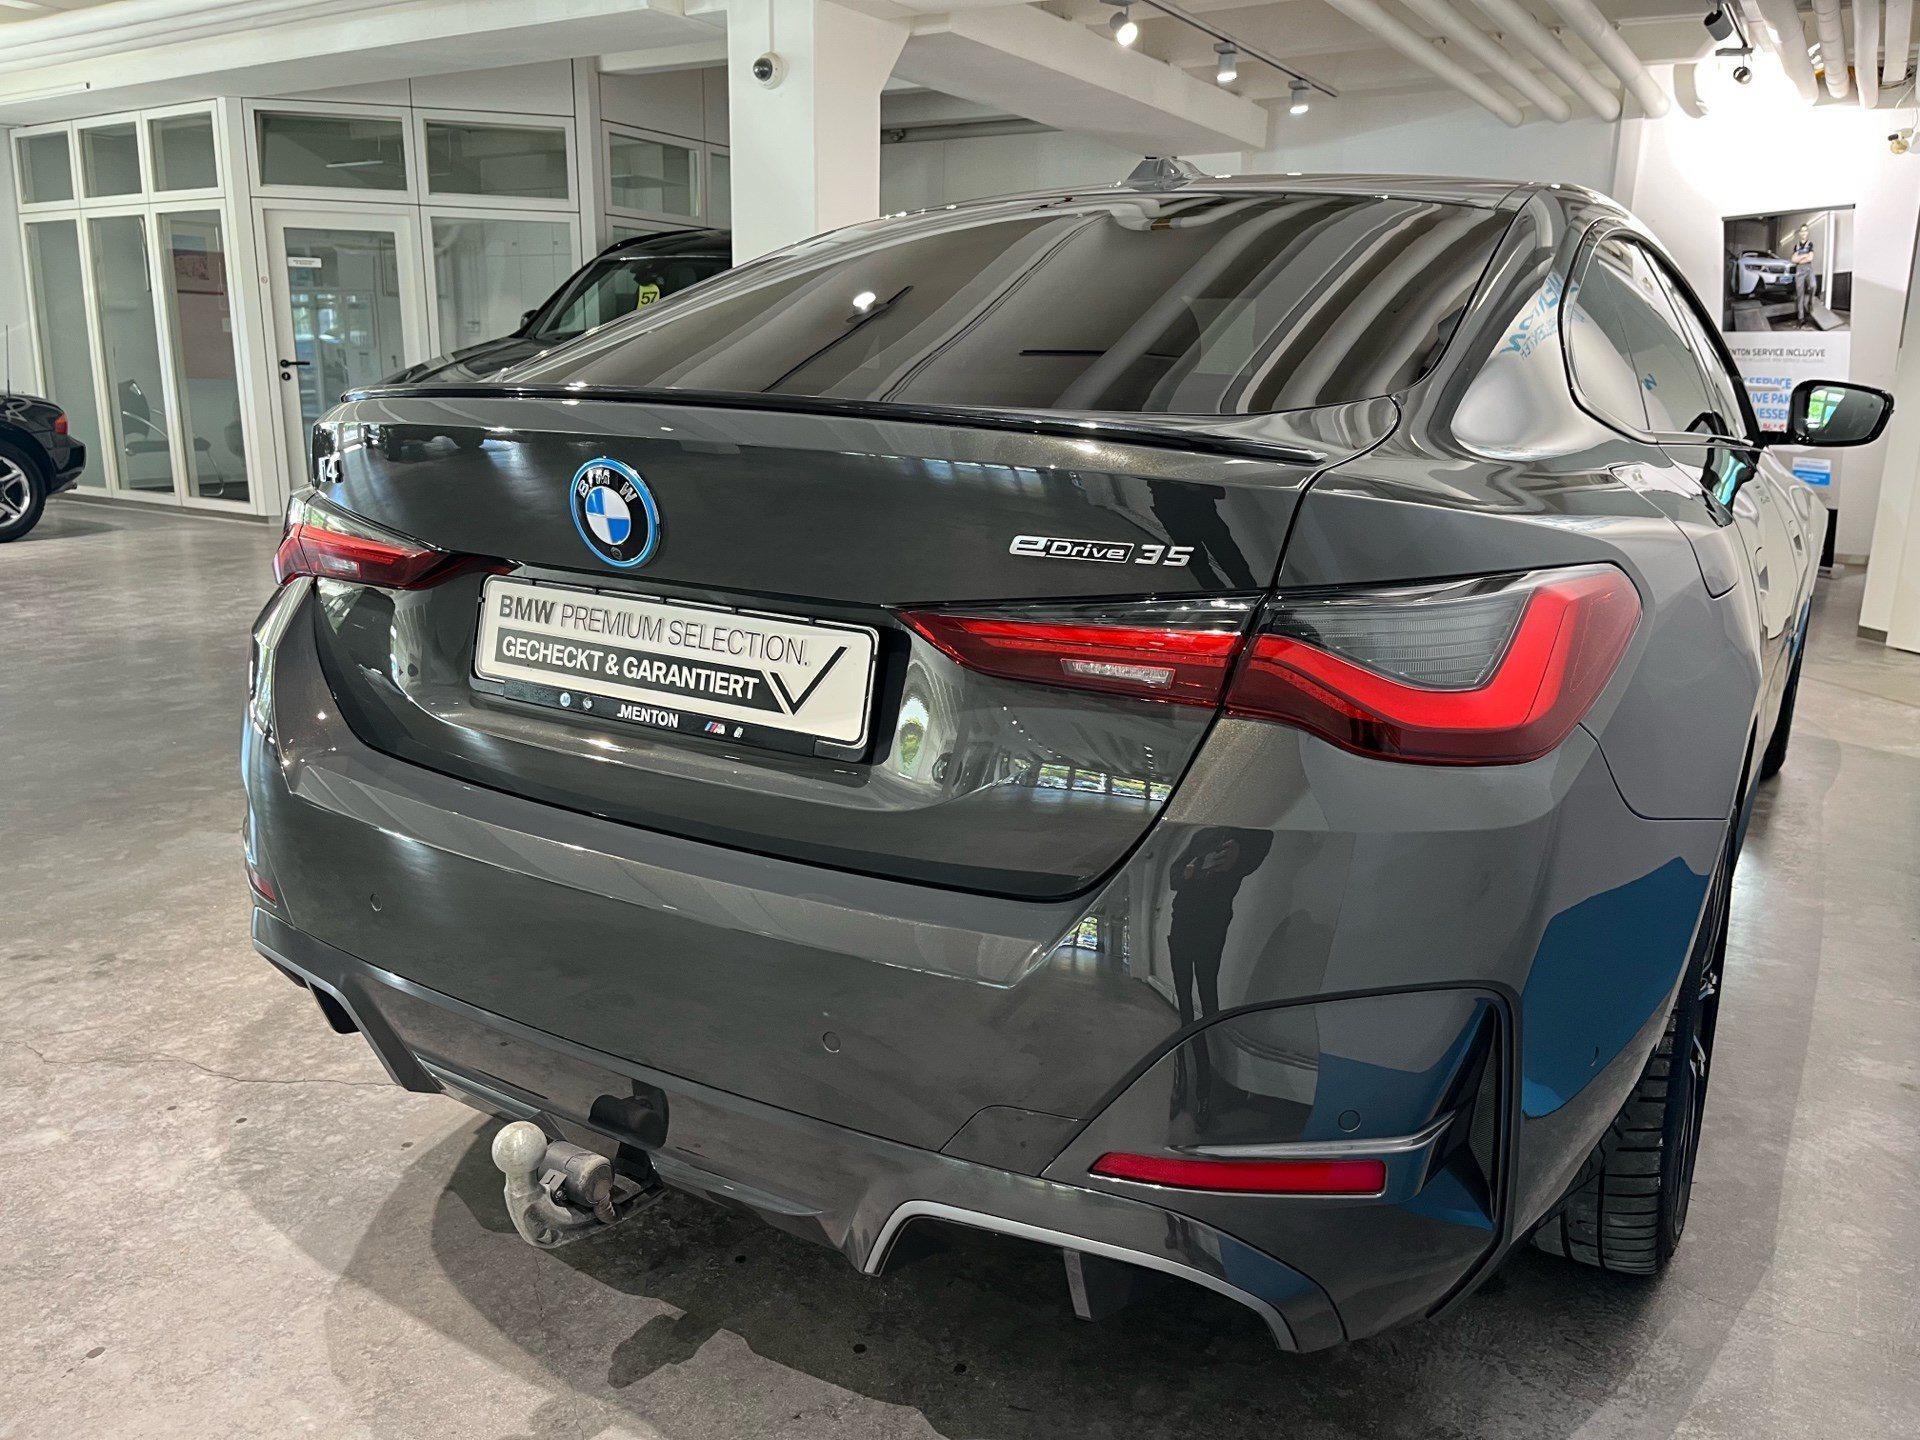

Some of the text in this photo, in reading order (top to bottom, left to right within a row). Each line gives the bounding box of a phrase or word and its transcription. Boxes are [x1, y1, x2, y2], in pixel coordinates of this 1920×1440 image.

[641, 291, 658, 305] 57
[1728, 347, 1826, 358] NTON SERVICE INCLUSIVE
[578, 468, 638, 503] BMW
[1009, 535, 1195, 567] eDrive 35
[499, 594, 810, 667] BMW PREMIUM SELECTION.
[502, 635, 760, 700] GECHECKT & GARANTIERT
